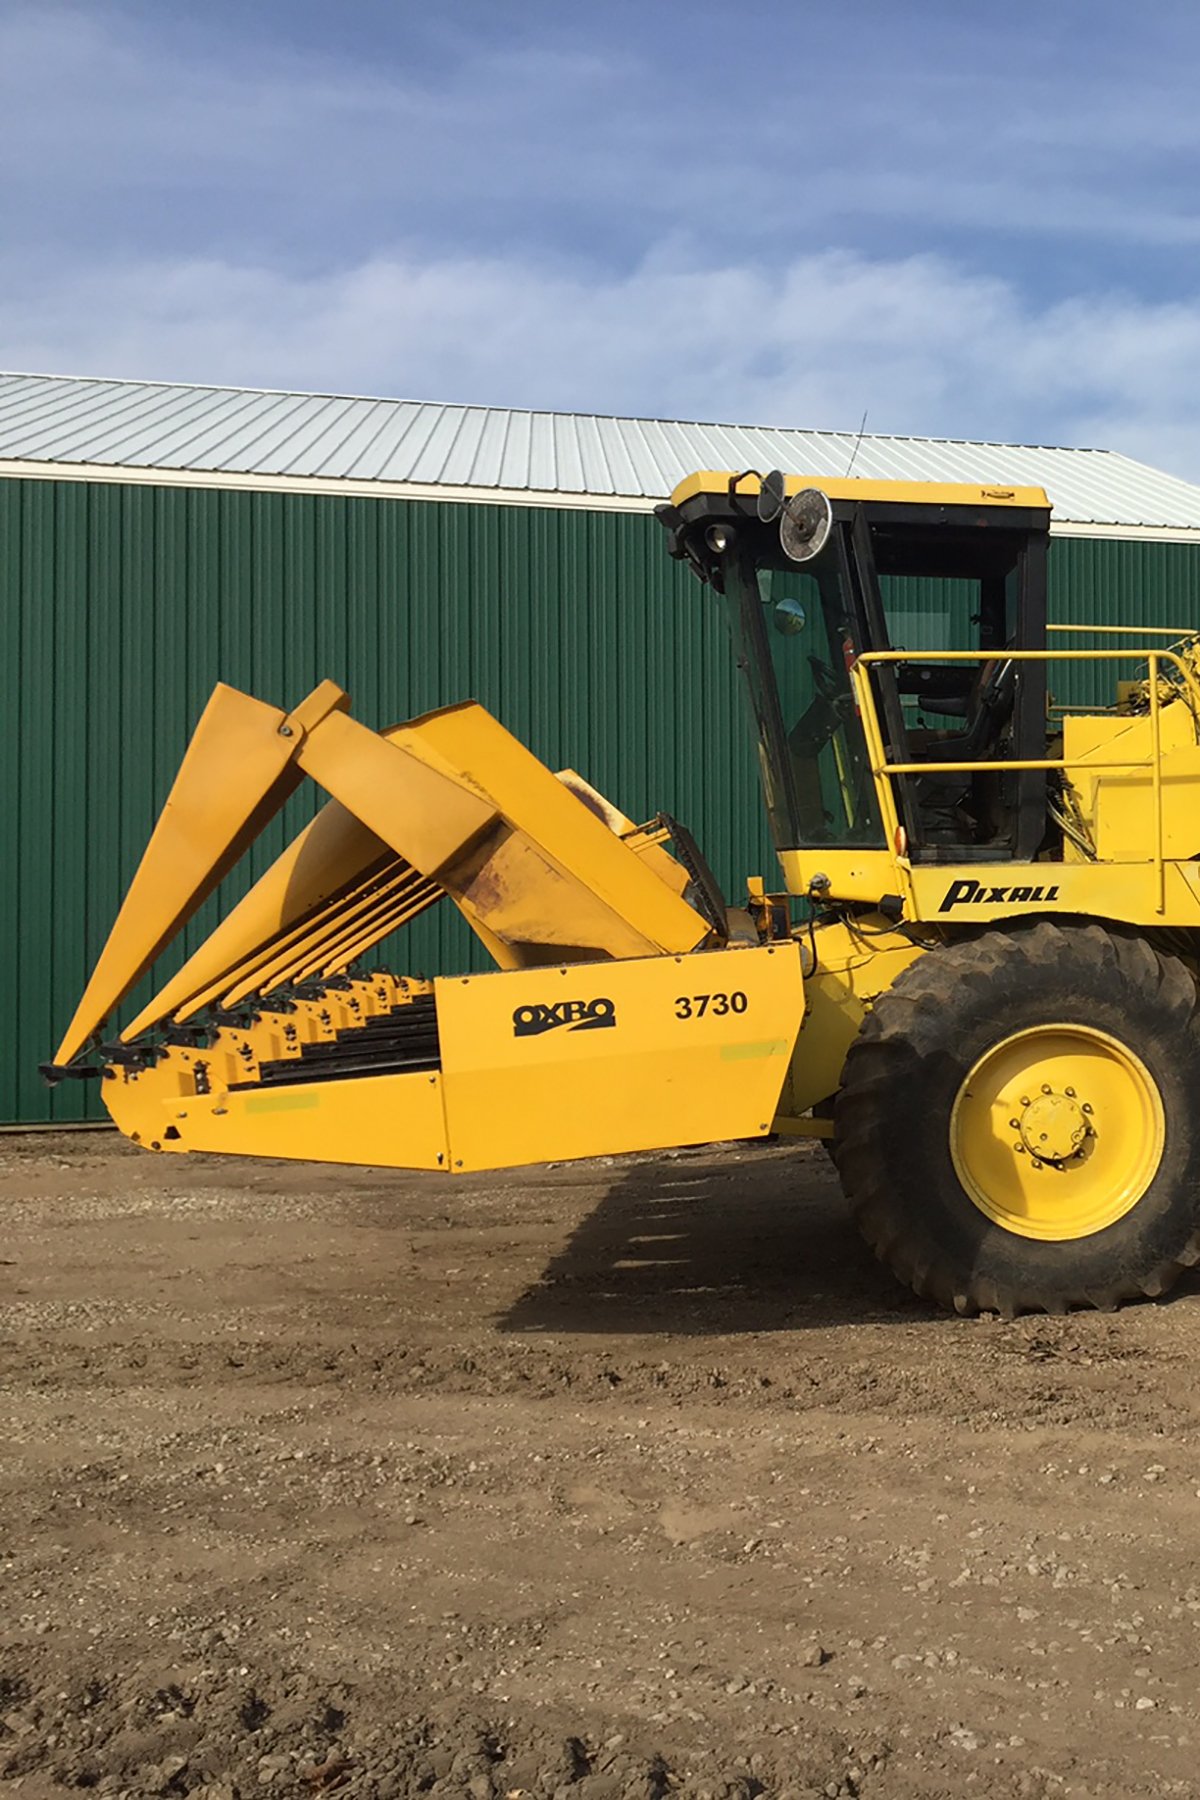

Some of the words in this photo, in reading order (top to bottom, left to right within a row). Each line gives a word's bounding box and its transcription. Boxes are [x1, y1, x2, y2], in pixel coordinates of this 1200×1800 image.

[938, 880, 1060, 912] PIXALL
[512, 998, 616, 1037] OXBO
[674, 991, 748, 1020] 3730
